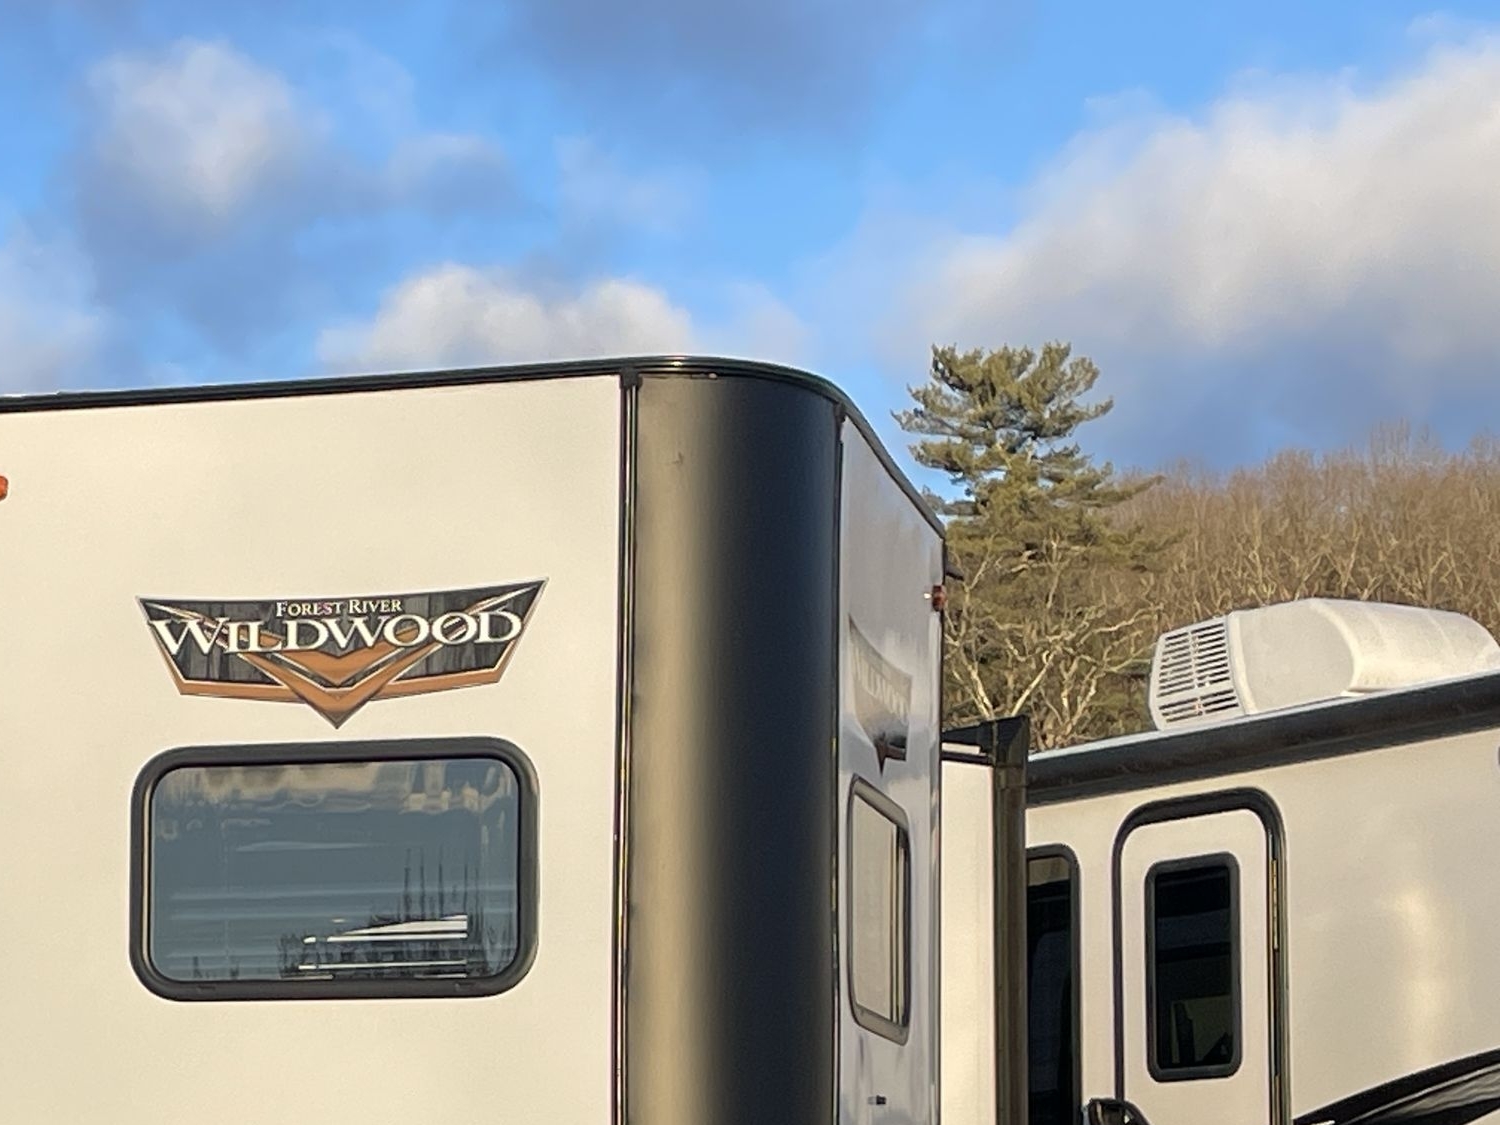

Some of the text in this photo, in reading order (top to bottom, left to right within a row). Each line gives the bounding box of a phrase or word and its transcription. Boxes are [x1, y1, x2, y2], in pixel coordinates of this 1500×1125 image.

[276, 598, 403, 617] FOREST RIVER
[149, 610, 522, 656] WILDWOOD
